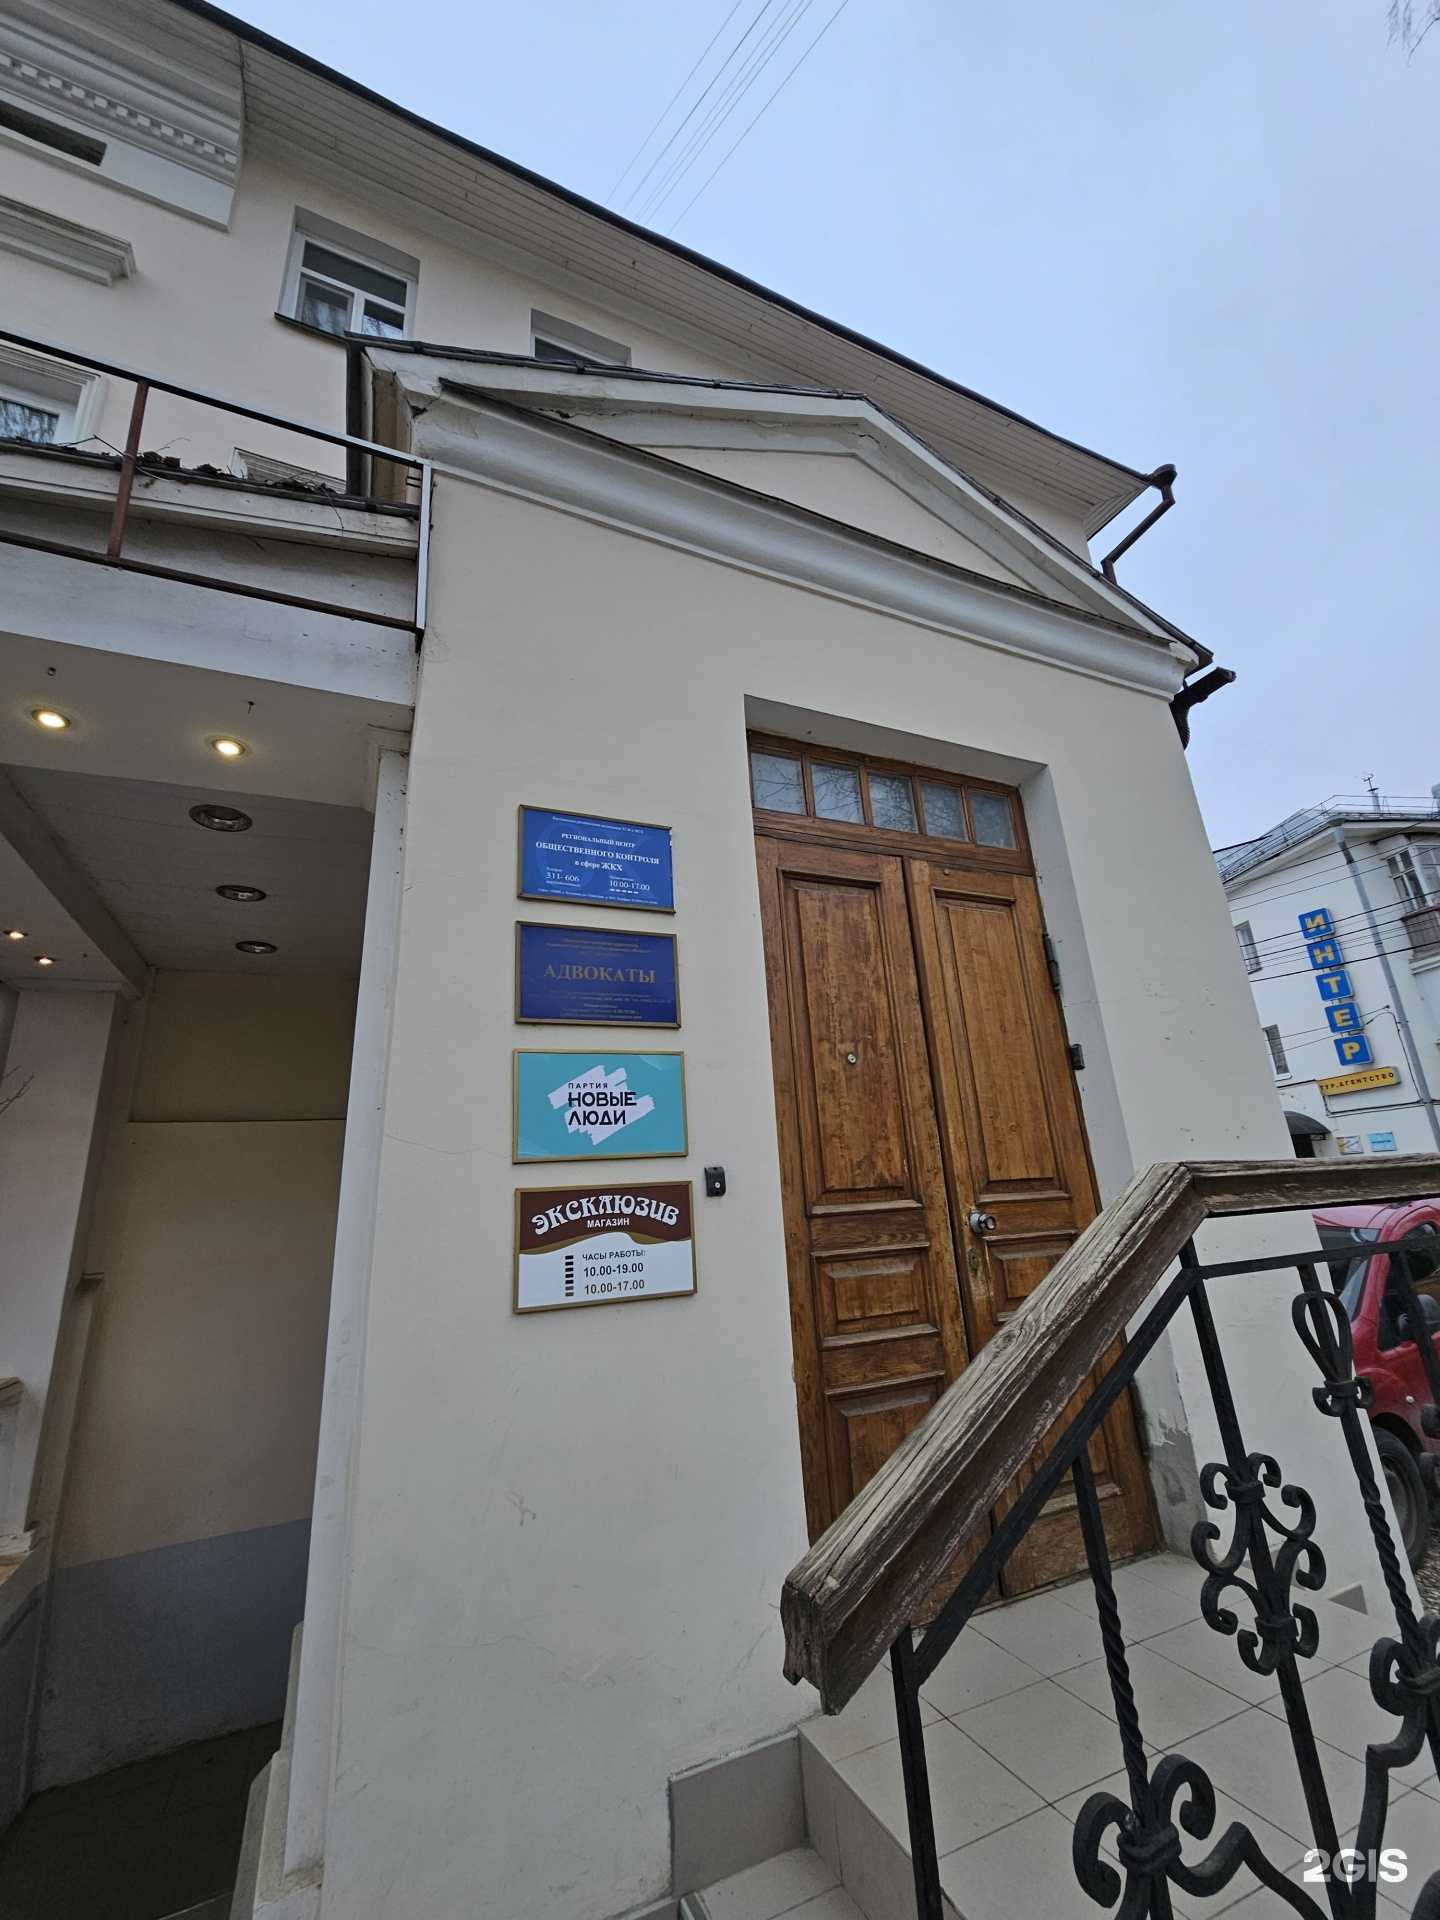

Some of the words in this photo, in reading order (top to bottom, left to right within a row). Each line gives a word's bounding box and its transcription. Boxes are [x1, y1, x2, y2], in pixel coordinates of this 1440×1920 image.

[561, 833, 615, 846] РЕГИОНАЛЬНЫЙ
[536, 841, 615, 859] ОБЩЕСТВЕННОГО
[615, 851, 660, 865] КОНТРОЛЯ
[601, 862, 623, 872] ЖКХ
[544, 964, 657, 984] АДВОКАТЫ
[1305, 913, 1361, 1061] ИНТЕР
[568, 1091, 637, 1107] НОВЫЕ
[568, 1110, 627, 1126] ЛЮДИ
[531, 1195, 680, 1235] ЭКСКЛЮЗИВ
[587, 1218, 630, 1228] МАГАЗИН
[582, 1251, 607, 1261] ЧАСЫ
[609, 1249, 646, 1259] РАБОТЫ:
[583, 1262, 644, 1277] 10.00-19.00
[584, 1279, 645, 1295] 10.00-17.00
